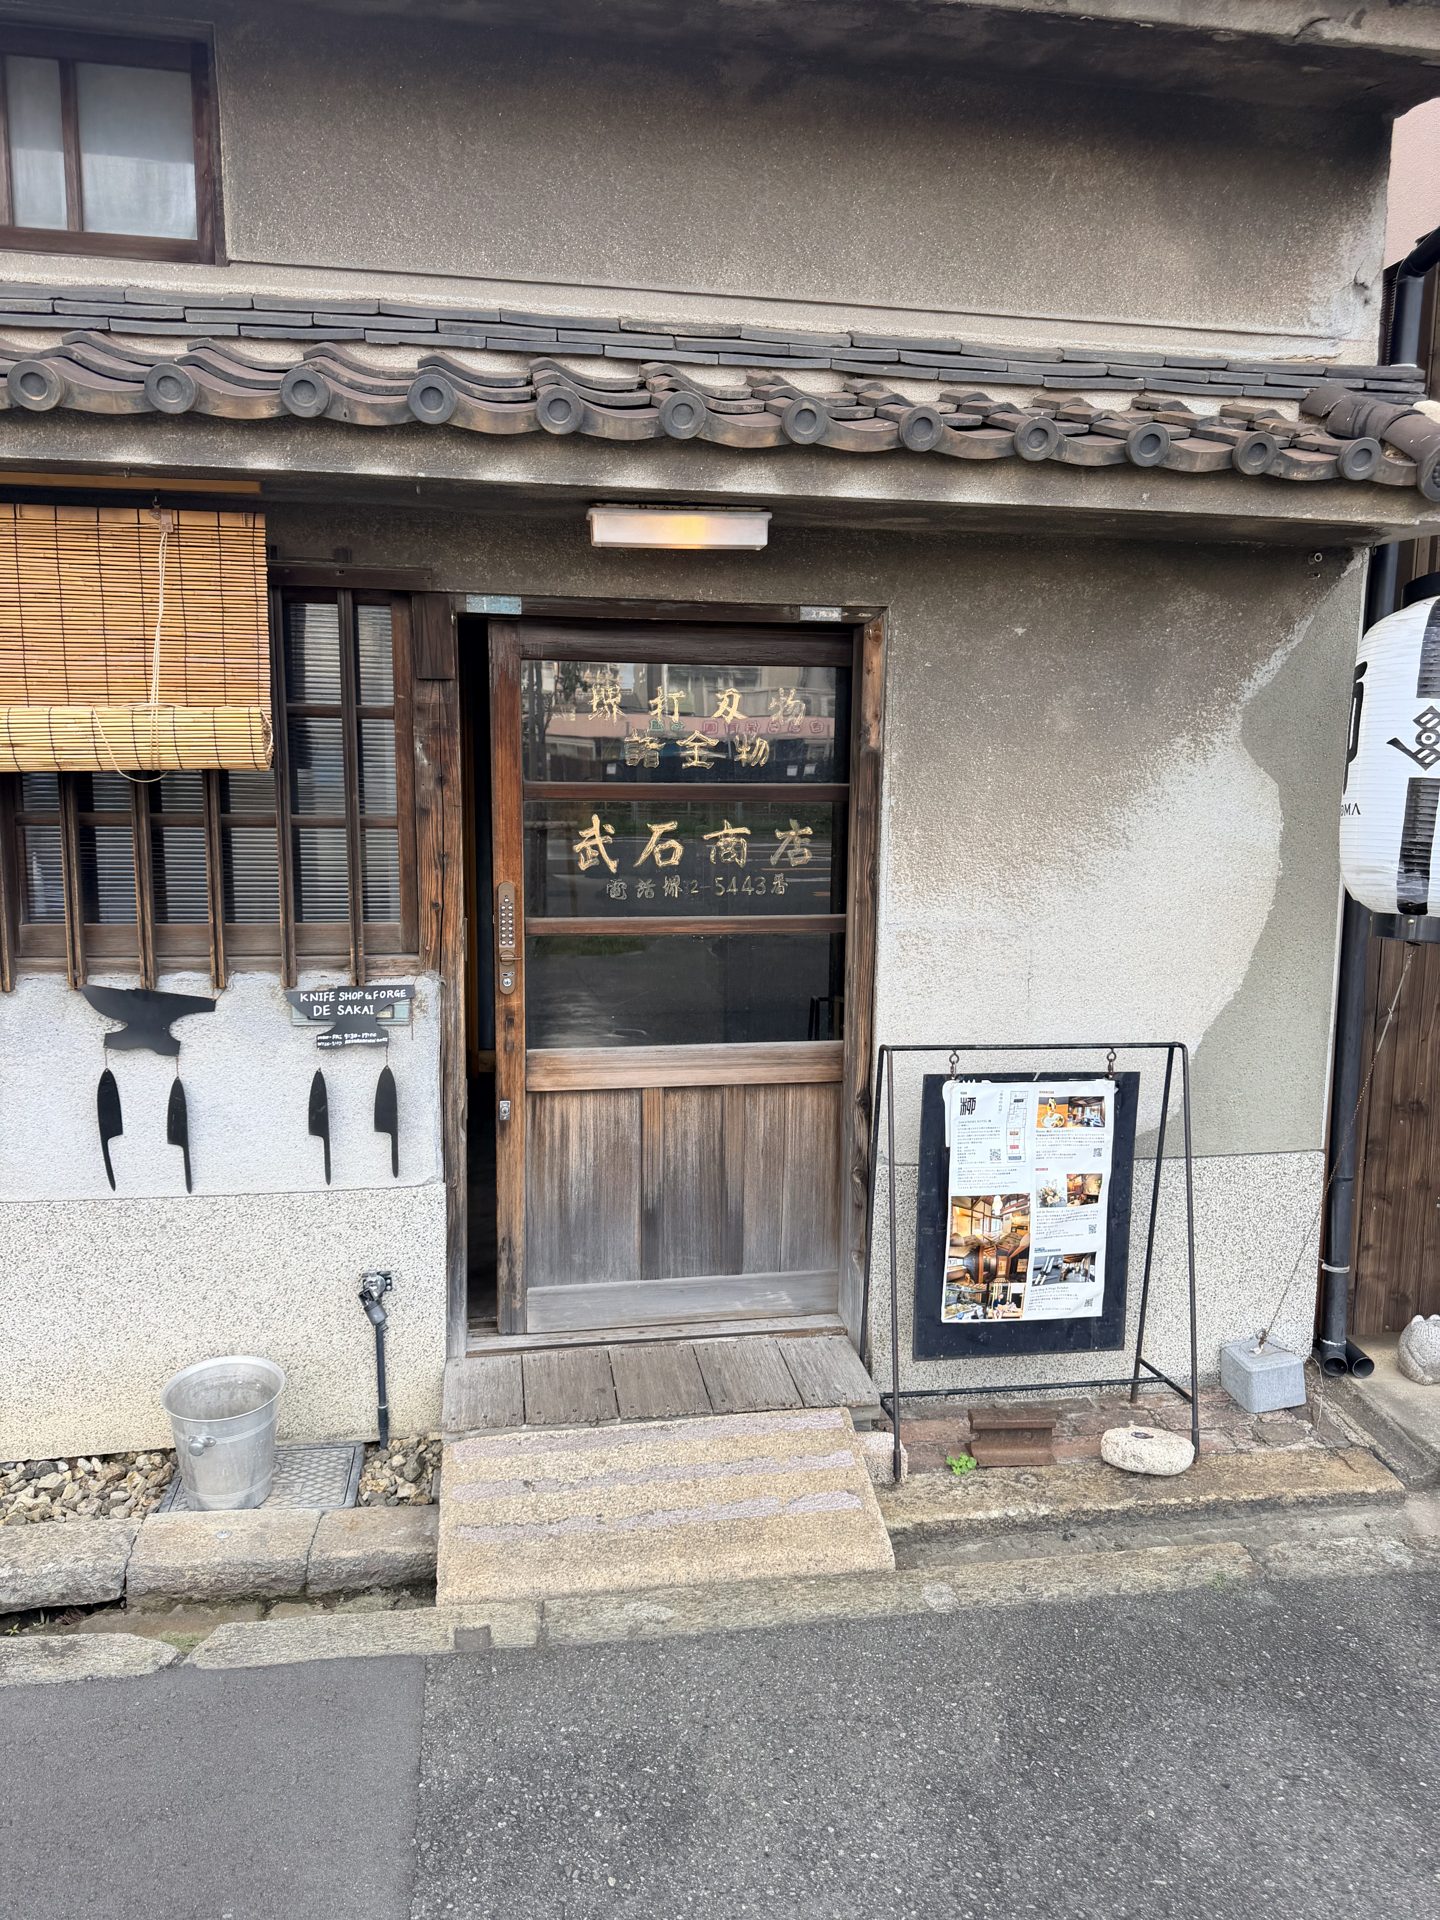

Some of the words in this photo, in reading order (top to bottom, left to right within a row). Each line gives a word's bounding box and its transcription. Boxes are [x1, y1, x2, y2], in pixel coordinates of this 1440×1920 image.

[573, 813, 812, 873] 武石商店
[300, 991, 335, 1003] KNIFE
[338, 990, 363, 1001] SHOP
[373, 989, 407, 1000] FORGE
[313, 1004, 331, 1017] DE
[337, 1004, 375, 1016] SAKAI
